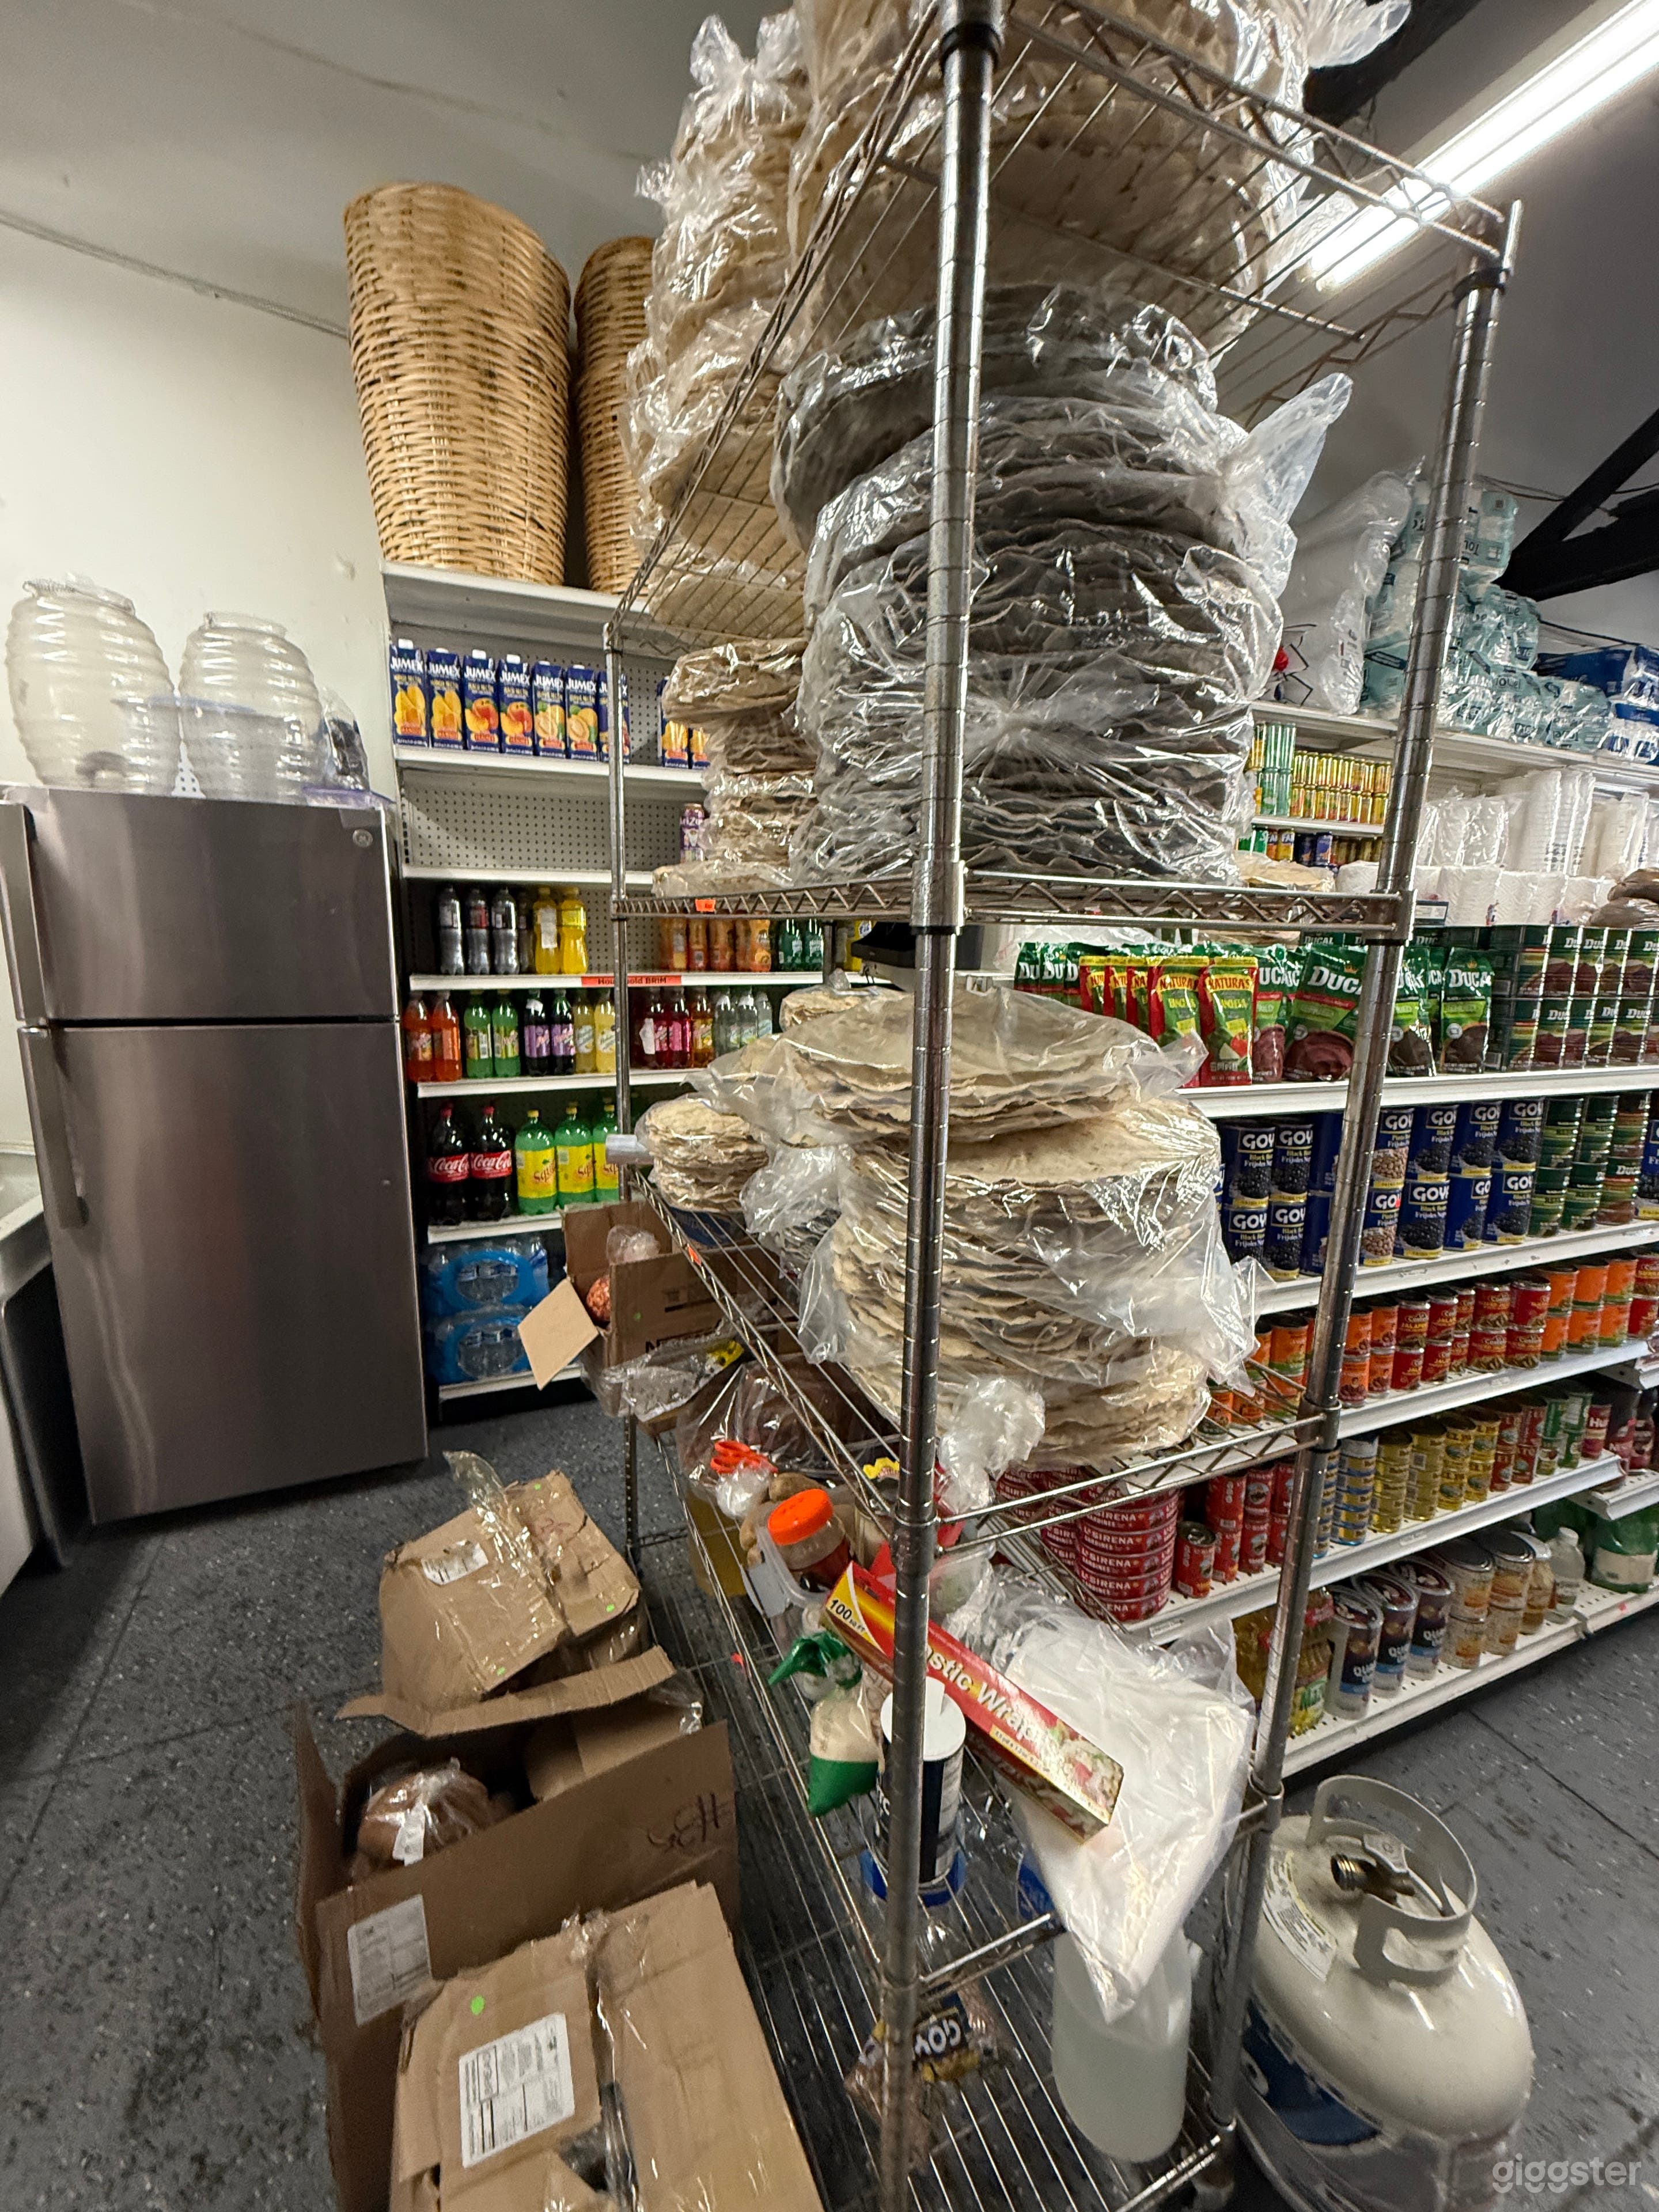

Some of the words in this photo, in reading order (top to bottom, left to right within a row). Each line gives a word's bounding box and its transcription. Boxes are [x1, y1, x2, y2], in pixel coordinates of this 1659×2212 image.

[391, 657, 423, 673] JUMEX
[427, 663, 461, 678] JUMEX
[464, 665, 497, 681] JUMEX
[500, 669, 530, 685] JUMEX
[533, 673, 563, 691] JUMEX
[567, 677, 597, 692] JUMEX
[599, 682, 628, 696] JUX
[1449, 969, 1491, 988] DUCA
[1243, 1133, 1275, 1150] GOY
[1279, 1130, 1313, 1146] GOY
[1413, 1185, 1449, 1202] GOY
[1233, 1213, 1267, 1230] GOY
[1275, 1207, 1306, 1224] GOY
[1092, 1532, 1134, 1545] SIRENA
[1089, 1554, 1131, 1567] SIRENA
[1089, 1577, 1131, 1590] SIRENA
[830, 1598, 853, 1620] 100
[927, 1647, 974, 1692] stic
[978, 1683, 1040, 1743] Wrap
[914, 2018, 961, 2057] GOY
